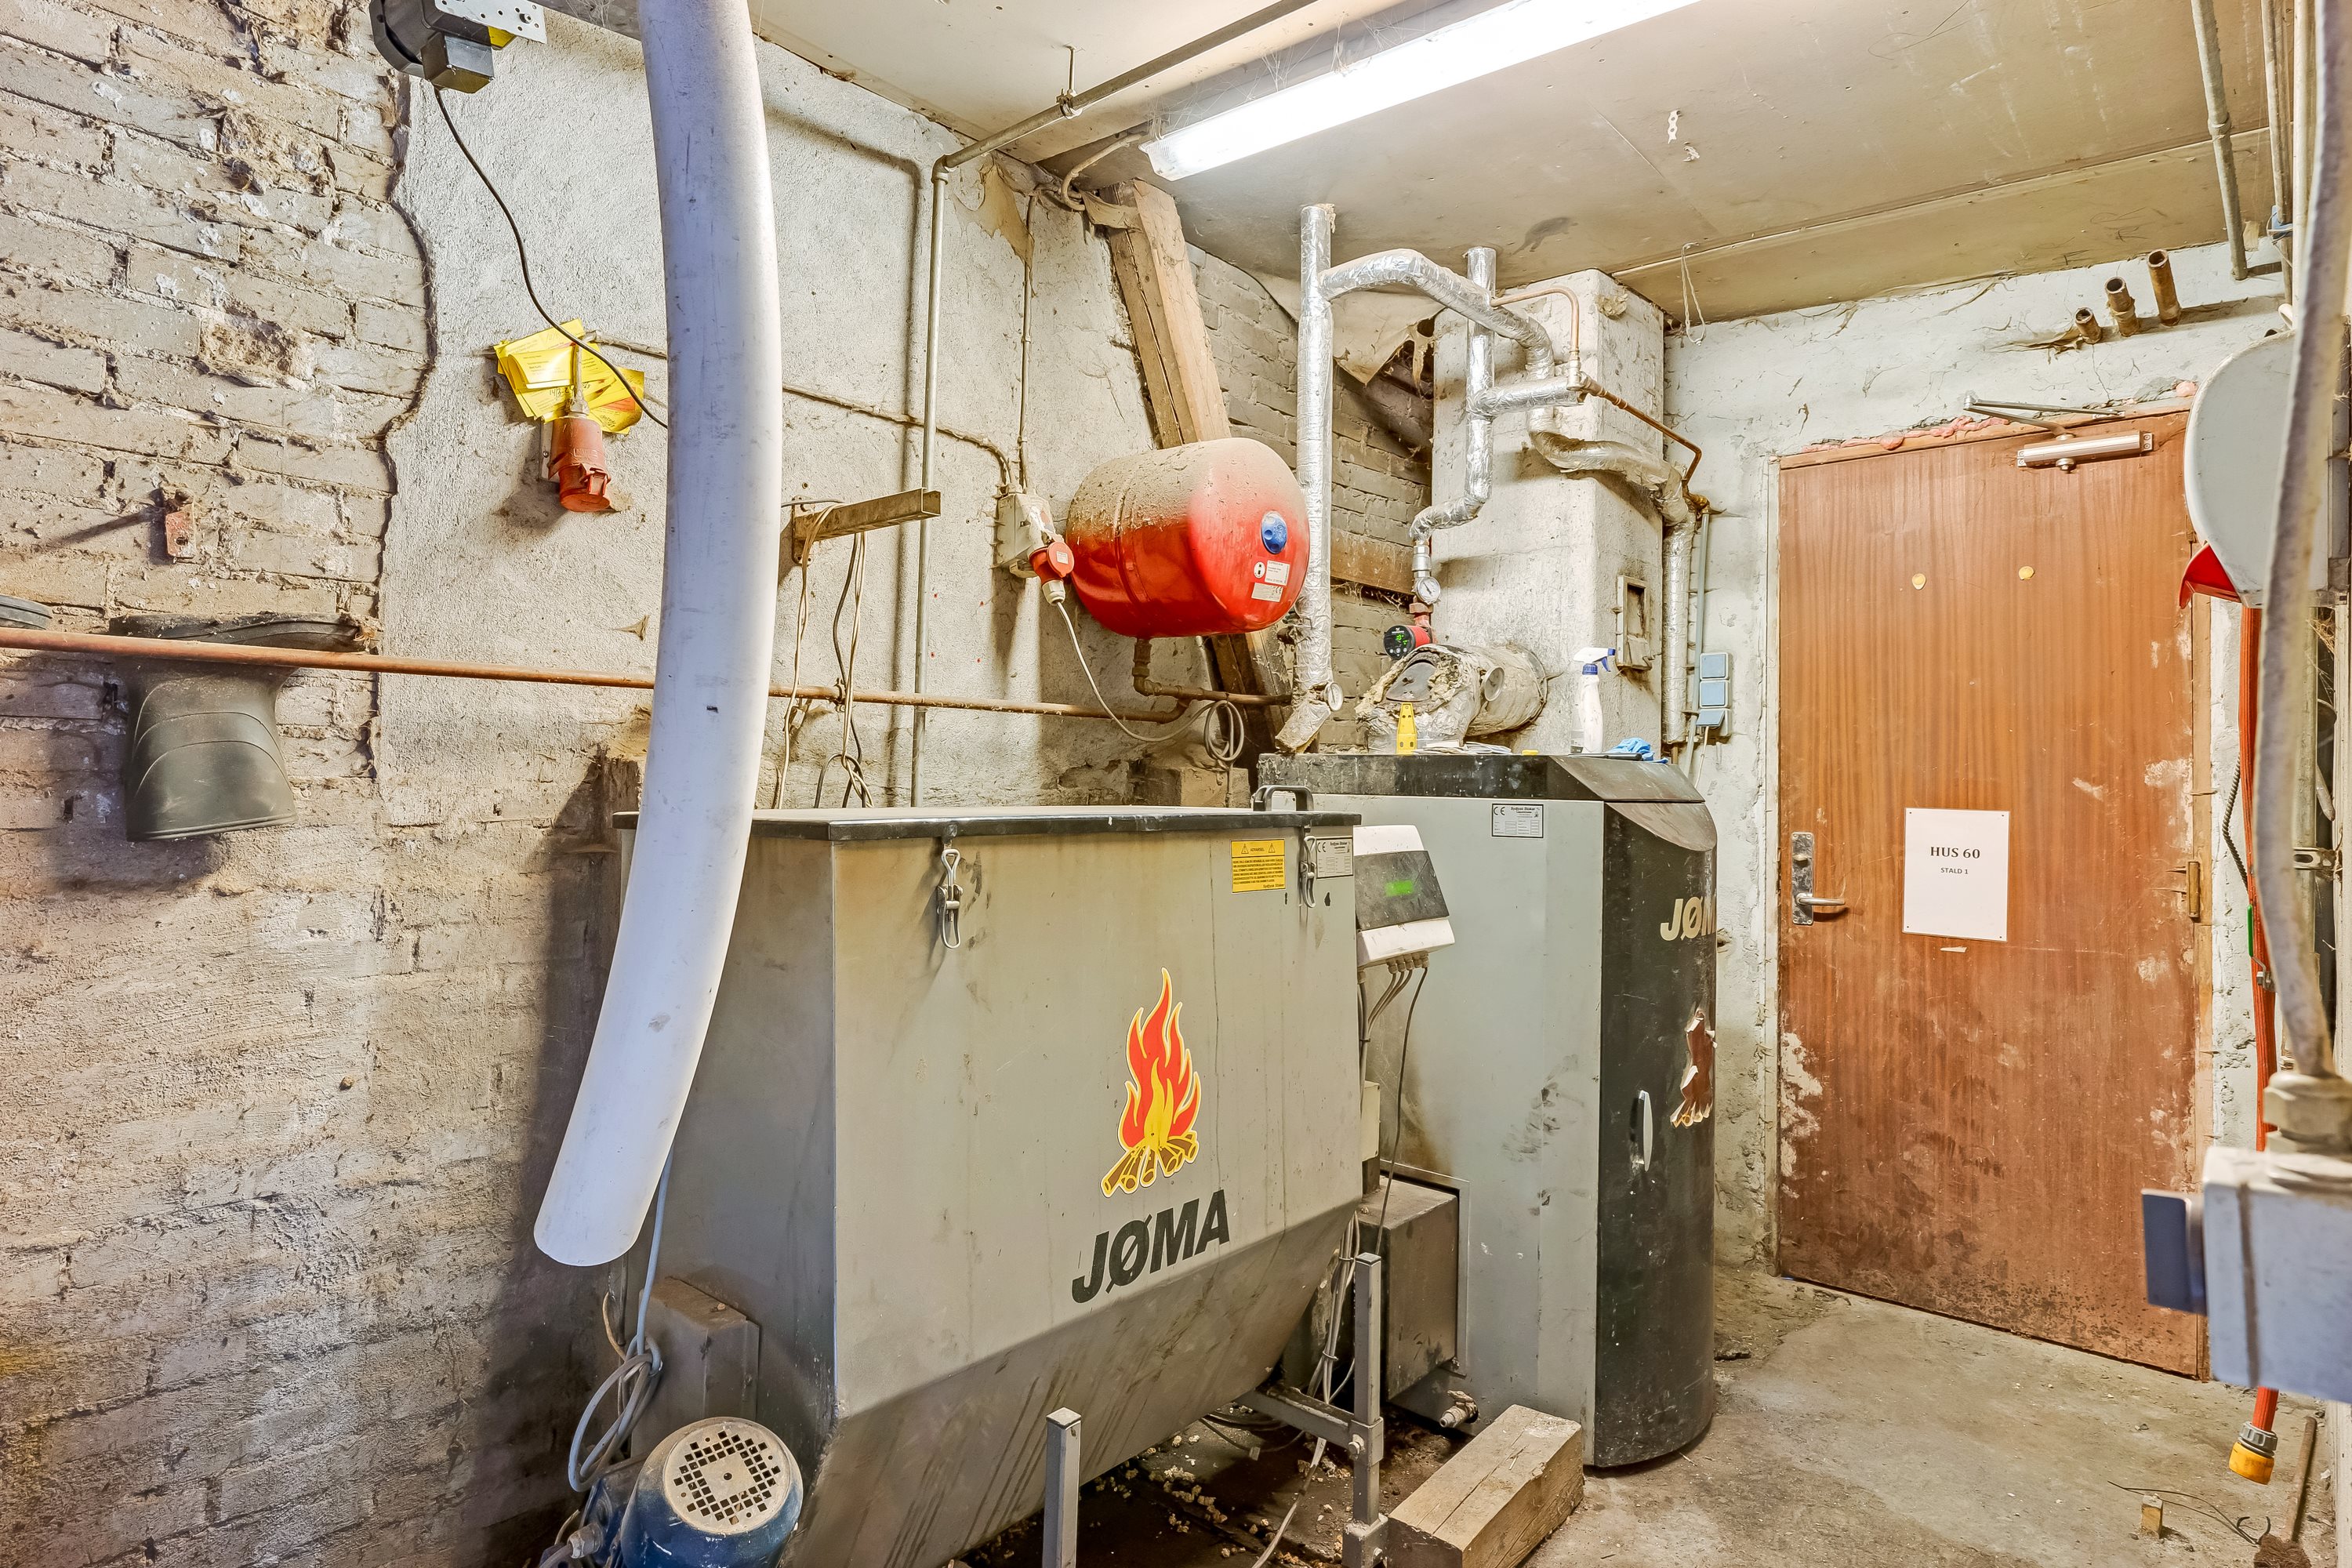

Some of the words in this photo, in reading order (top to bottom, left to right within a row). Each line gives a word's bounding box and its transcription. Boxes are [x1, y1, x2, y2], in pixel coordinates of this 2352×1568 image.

[1931, 847, 1958, 858] HUS
[1963, 848, 1980, 858] 60
[1660, 895, 1716, 941] JØM
[1072, 1189, 1230, 1304] JØMA
